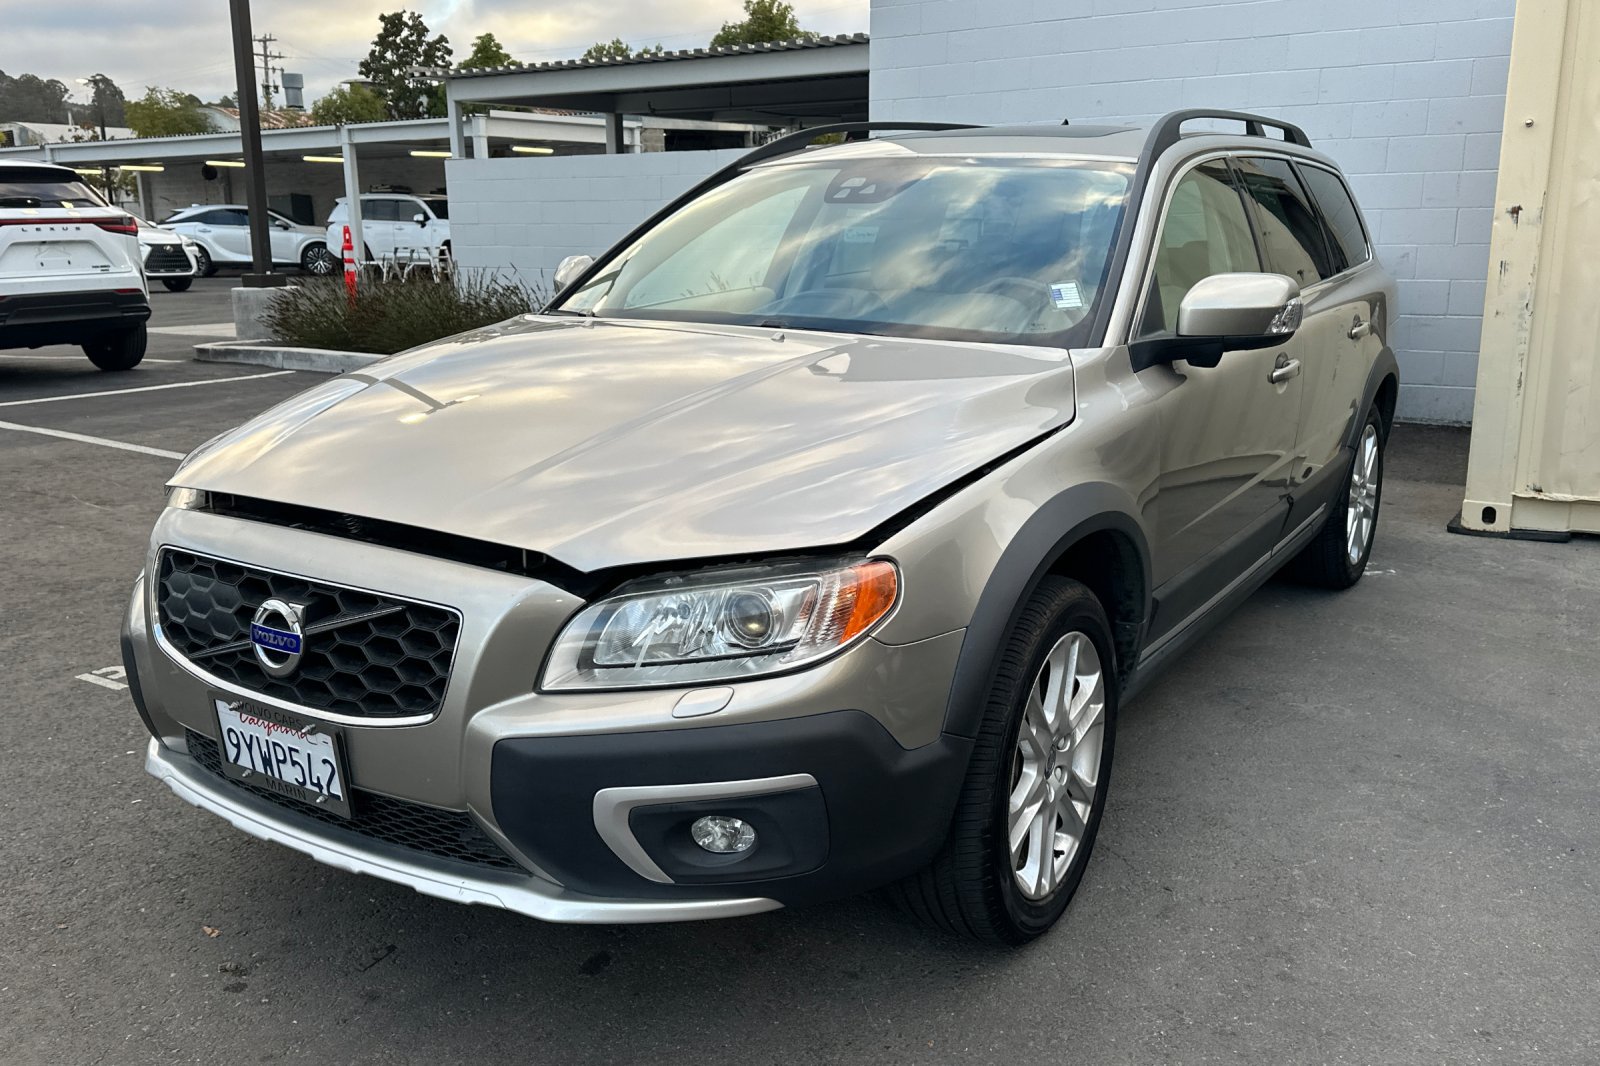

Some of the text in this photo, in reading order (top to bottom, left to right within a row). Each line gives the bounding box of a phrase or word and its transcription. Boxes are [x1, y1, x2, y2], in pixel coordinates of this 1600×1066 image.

[252, 627, 297, 649] VOLVO
[238, 701, 272, 720] VOLVO
[226, 727, 342, 801] 9YWP542
[265, 777, 307, 801] MARIN
